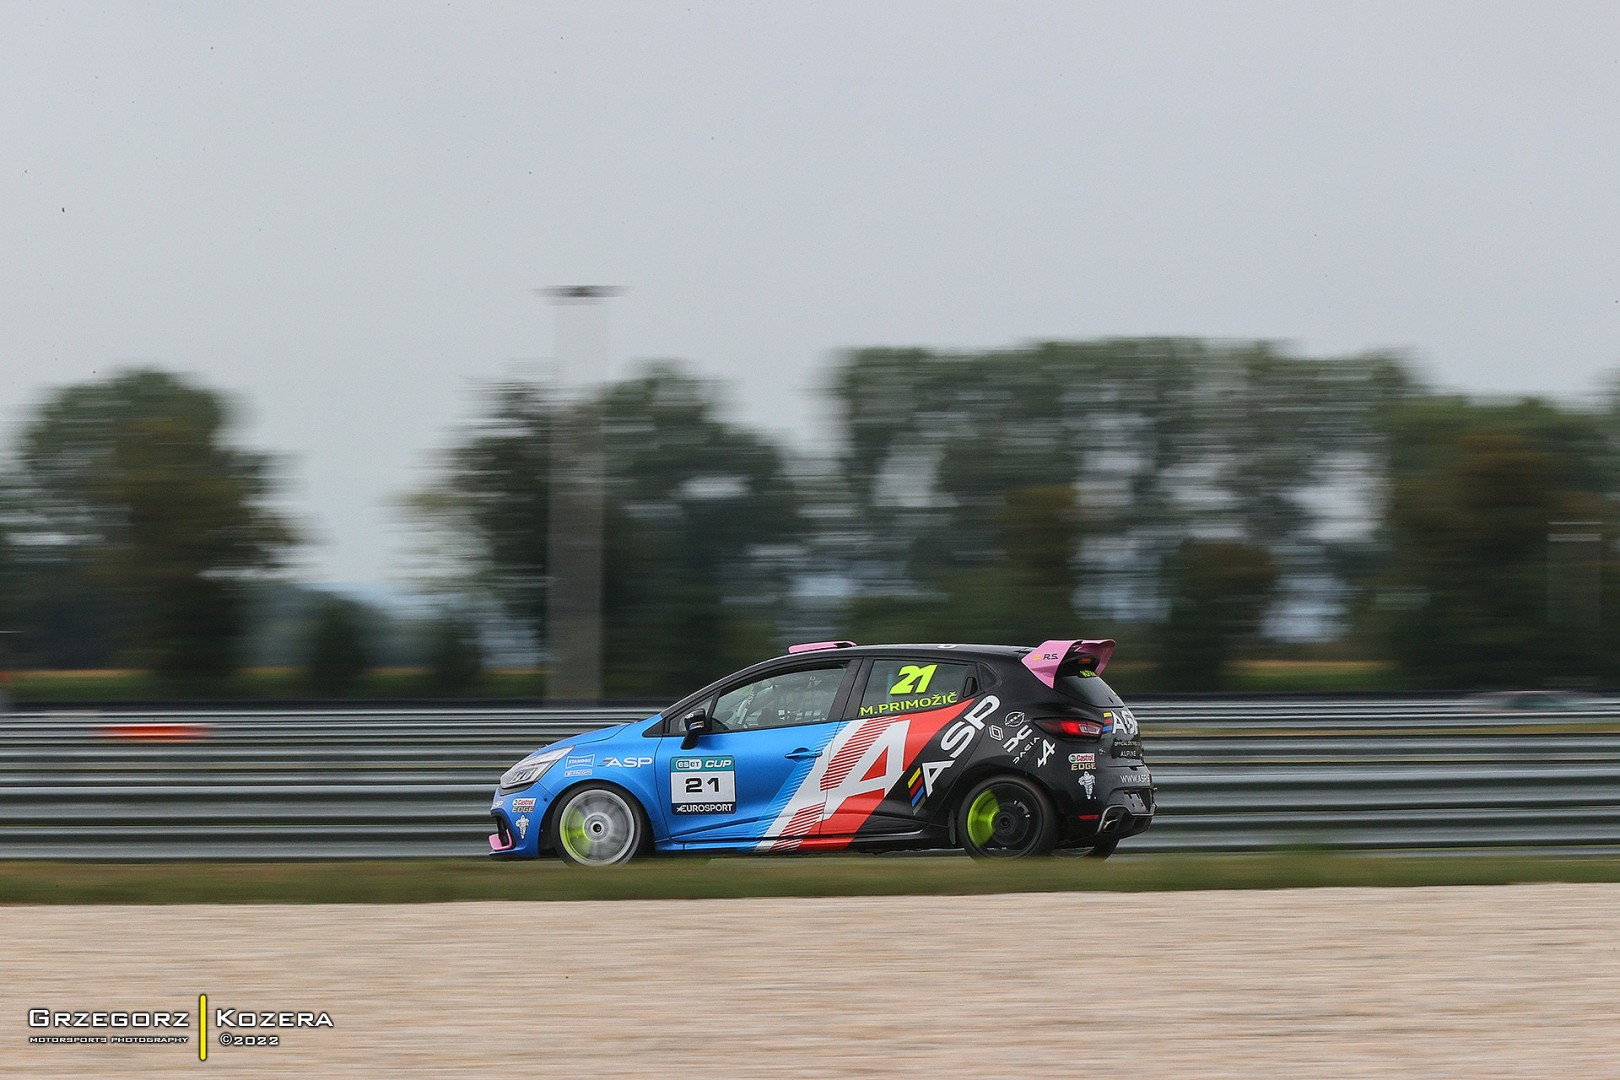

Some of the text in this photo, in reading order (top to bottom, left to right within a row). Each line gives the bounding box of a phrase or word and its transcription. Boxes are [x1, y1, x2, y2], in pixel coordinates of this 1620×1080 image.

[889, 664, 938, 695] 21
[860, 691, 958, 716] M.PRIMOŽIČ
[921, 695, 1001, 797] ASP
[606, 756, 653, 768] ASP
[705, 760, 732, 768] CUP
[1071, 762, 1097, 771] EDGE
[685, 777, 720, 793] 21
[676, 803, 733, 812] EUROSPORT
